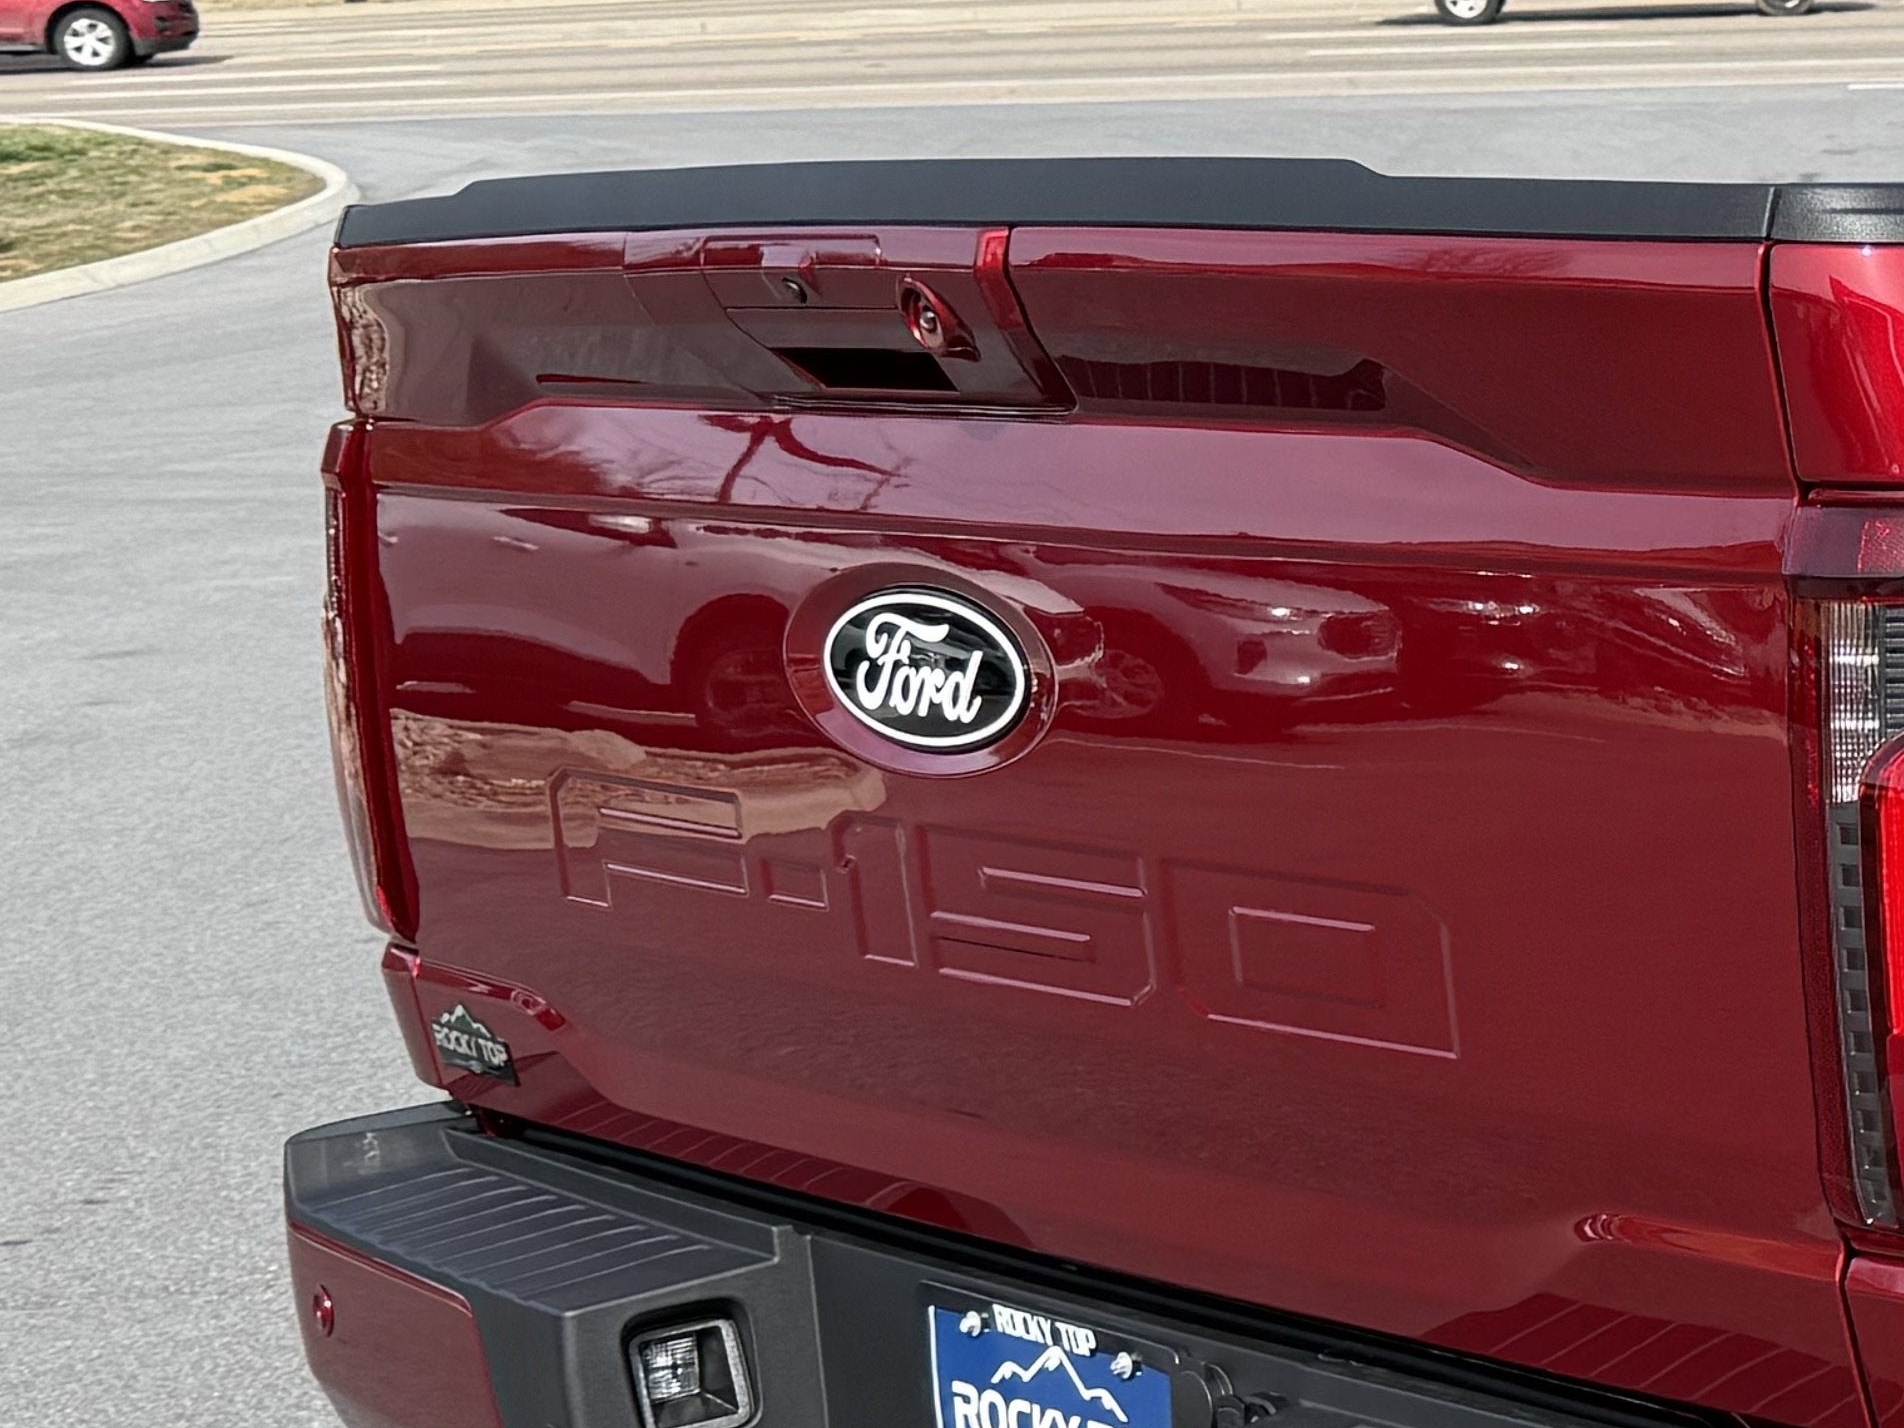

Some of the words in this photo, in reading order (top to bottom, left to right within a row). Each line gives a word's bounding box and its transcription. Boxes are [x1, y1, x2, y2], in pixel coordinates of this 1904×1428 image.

[856, 612, 983, 724] Ford
[548, 766, 1460, 1059] F-150
[432, 1023, 477, 1058] ROCKY
[478, 1038, 509, 1067] TOP
[992, 1304, 1054, 1347] ROCKY
[1053, 1321, 1097, 1357] TOP
